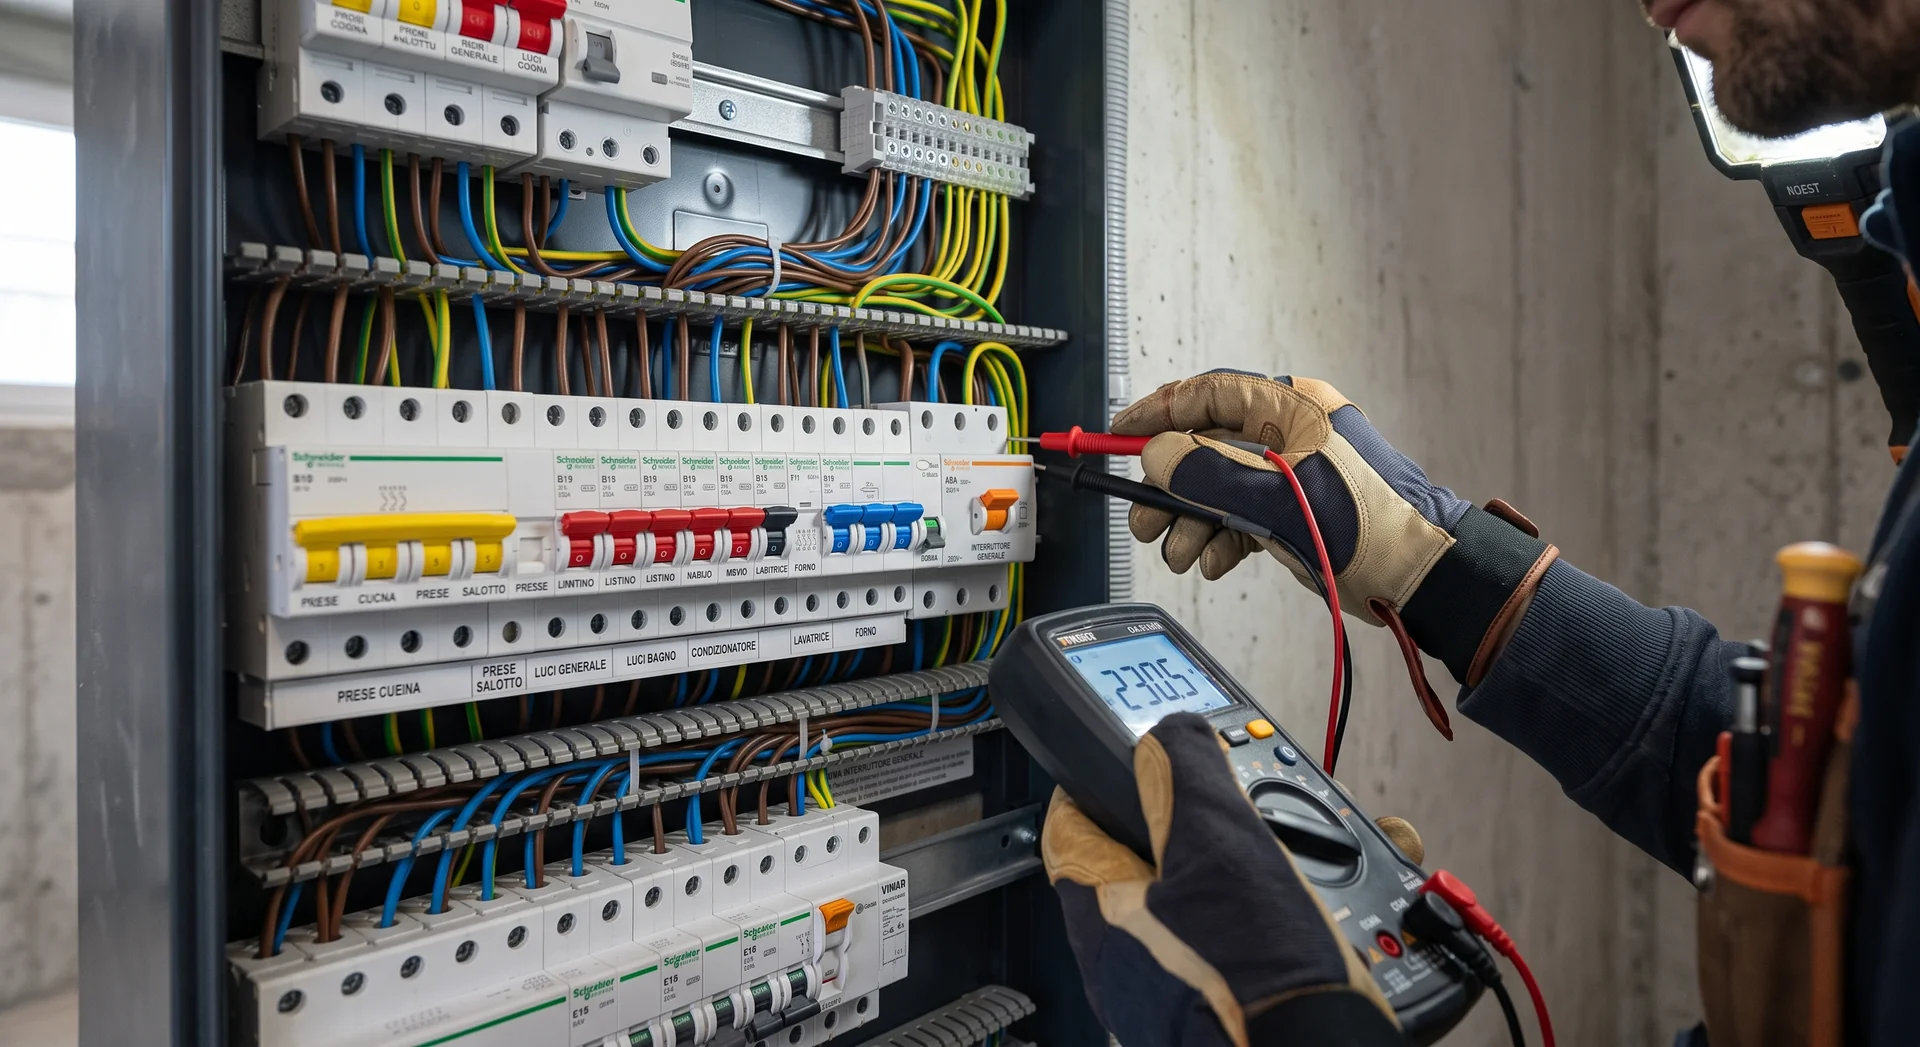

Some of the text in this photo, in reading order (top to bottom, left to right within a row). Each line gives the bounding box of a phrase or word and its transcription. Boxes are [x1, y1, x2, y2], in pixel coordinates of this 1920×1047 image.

[450, 46, 499, 64] GENERALE
[521, 52, 542, 64] LUCI
[1786, 182, 1821, 197] NOEST
[971, 541, 1011, 551] INTERRUTTORE
[977, 552, 1005, 561] GENERALE
[794, 562, 816, 572] FORNO
[605, 575, 636, 587] LISTINO
[646, 572, 676, 583] LISTINO
[416, 587, 450, 599] PRESE
[462, 585, 507, 597] SALOTTO
[515, 581, 549, 593] PRESSE
[793, 631, 830, 646] LAVATRICE
[855, 626, 877, 638] FORNO
[691, 640, 757, 658] CONDIZIONATORE
[626, 650, 677, 666] LUCI BAGNO
[482, 663, 517, 678] PRESE
[534, 659, 607, 678] LUCI GENERALE
[476, 676, 524, 693] SALOTTO
[337, 686, 377, 704] PRESE
